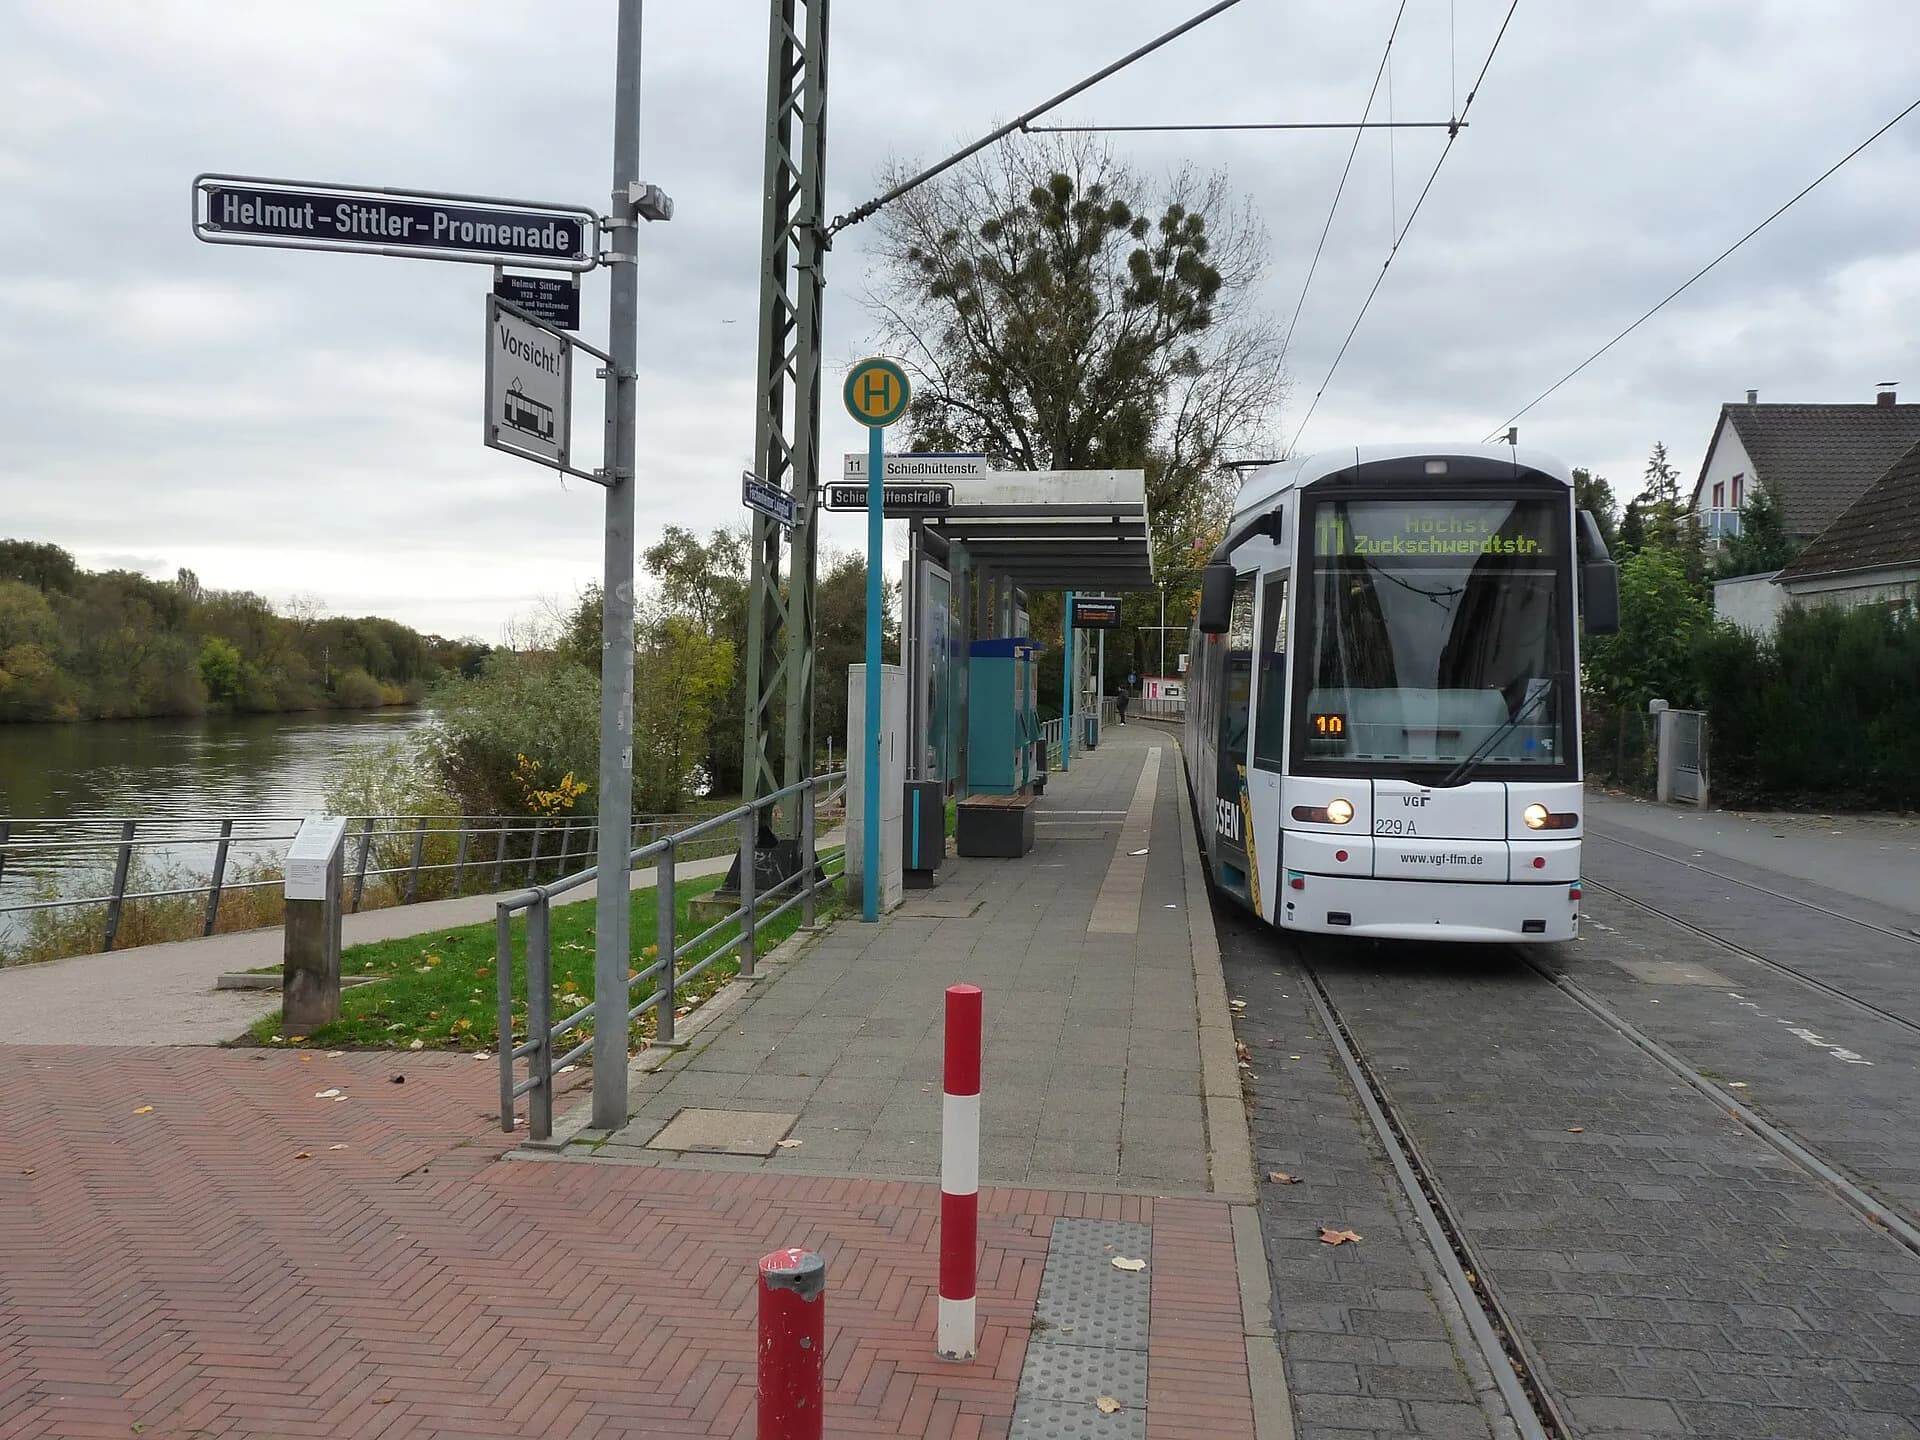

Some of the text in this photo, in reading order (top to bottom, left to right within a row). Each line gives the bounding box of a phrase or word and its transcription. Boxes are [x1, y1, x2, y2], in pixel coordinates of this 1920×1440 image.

[223, 194, 569, 251] Helmut-Sittler-Promenade
[511, 279, 562, 291] Helmut Sittler
[501, 325, 560, 377] Vorsicht!
[864, 374, 890, 411] H
[848, 460, 978, 475] 11 Schießhüttenstr.
[836, 489, 941, 505] Schiettenstraße
[1405, 515, 1490, 533] Höchst
[1315, 516, 1344, 555] 11
[1354, 535, 1543, 554] Zuckschwerdtstr.
[1316, 715, 1342, 735] 10
[1403, 790, 1431, 807] VGF
[1376, 819, 1417, 835] 229 A
[1400, 854, 1483, 866] www.vgf-ffm.de
